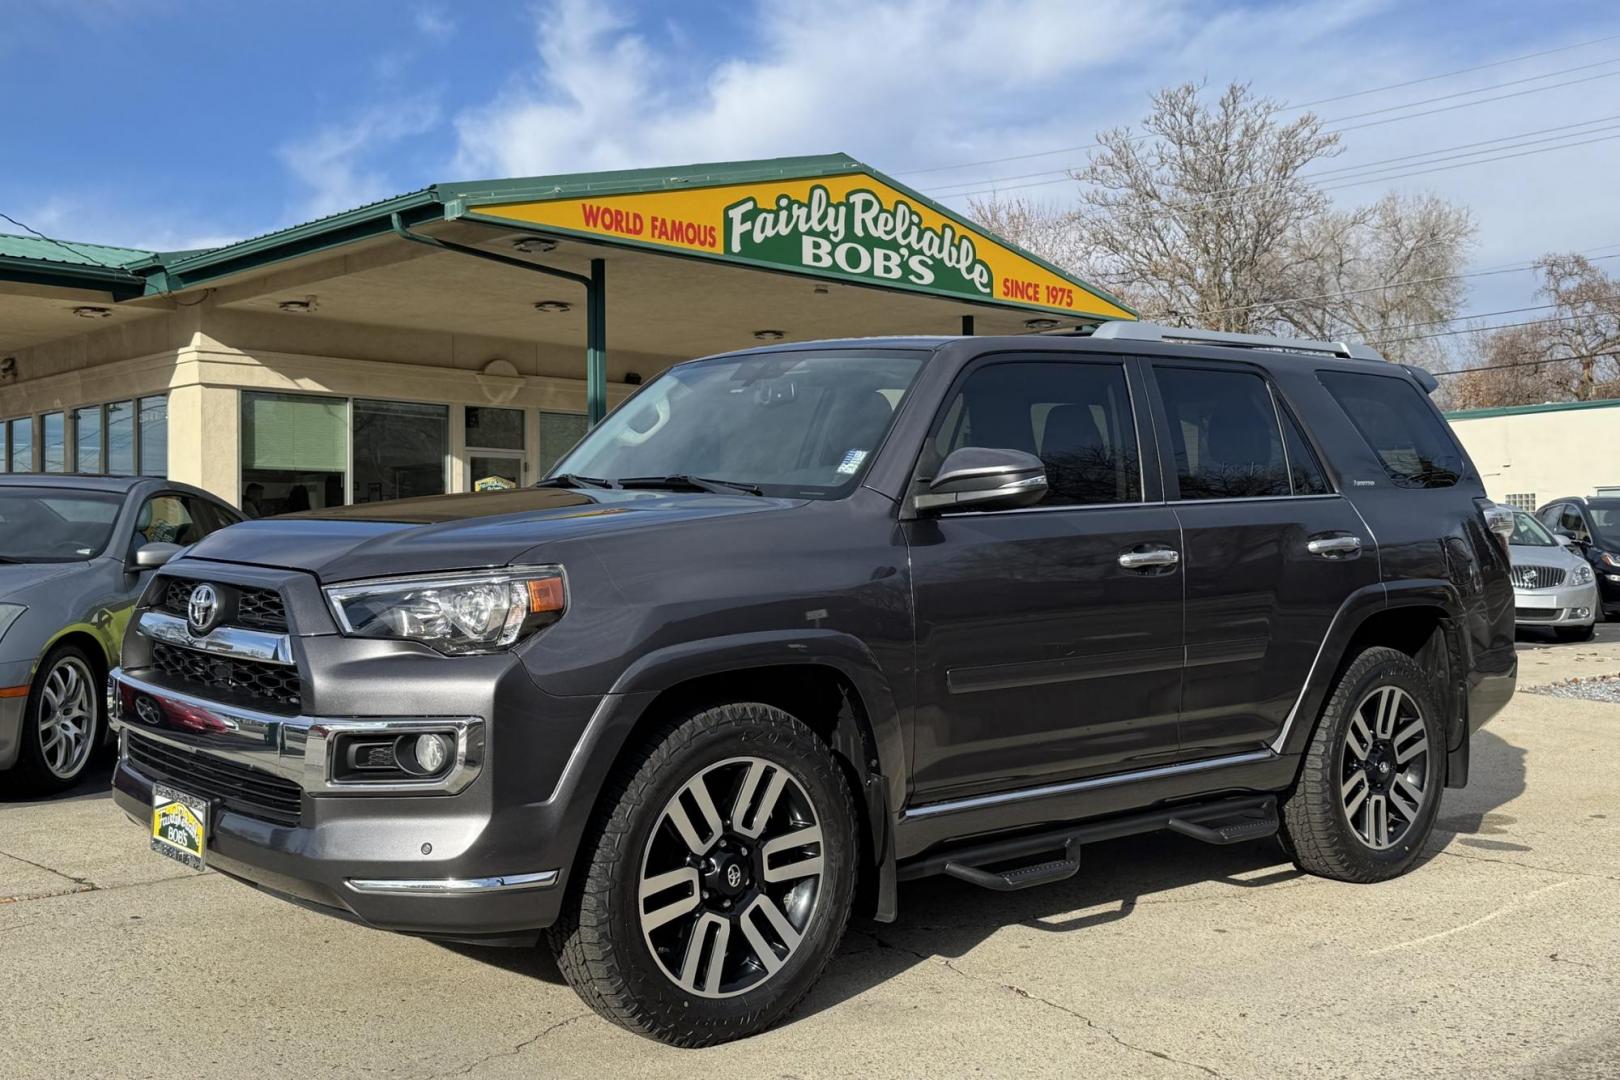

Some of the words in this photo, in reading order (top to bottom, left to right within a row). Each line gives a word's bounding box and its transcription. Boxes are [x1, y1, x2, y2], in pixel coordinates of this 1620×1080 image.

[582, 203, 643, 235] WORLD
[651, 216, 716, 248] FAMOUS
[729, 188, 846, 253] Fairly
[849, 192, 990, 293] Reliable
[802, 235, 935, 285] BOB'S
[1003, 277, 1039, 302] SINCE
[1045, 285, 1073, 307] 1975
